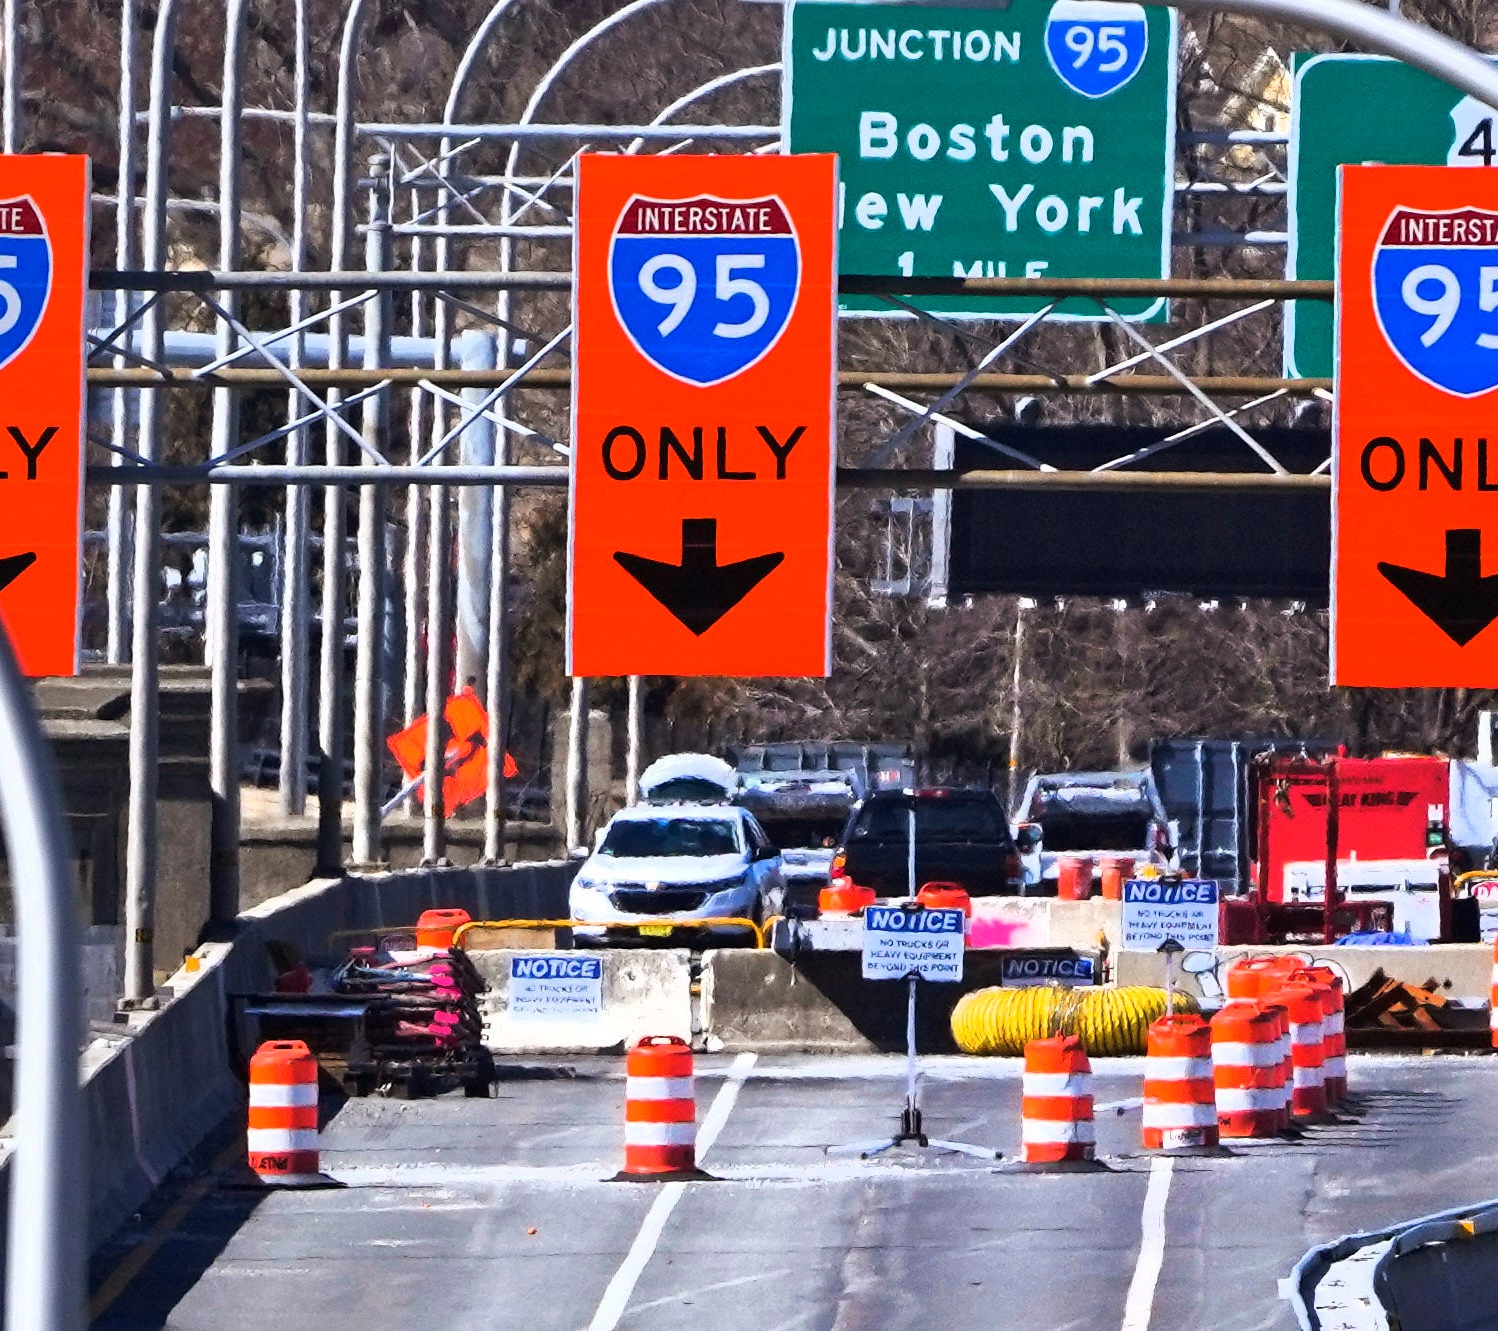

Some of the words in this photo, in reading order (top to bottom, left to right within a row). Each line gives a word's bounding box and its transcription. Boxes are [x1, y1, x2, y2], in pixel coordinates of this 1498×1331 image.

[812, 27, 1022, 64] JUNCTION
[1064, 25, 1129, 73] 95
[859, 111, 1095, 164] Boston
[637, 206, 773, 232] INTERSTATE
[988, 183, 1144, 235] York
[637, 253, 771, 339] 95
[601, 424, 809, 482] ONLY
[516, 959, 598, 978] NOTICE
[1007, 960, 1087, 977] NOTICE
